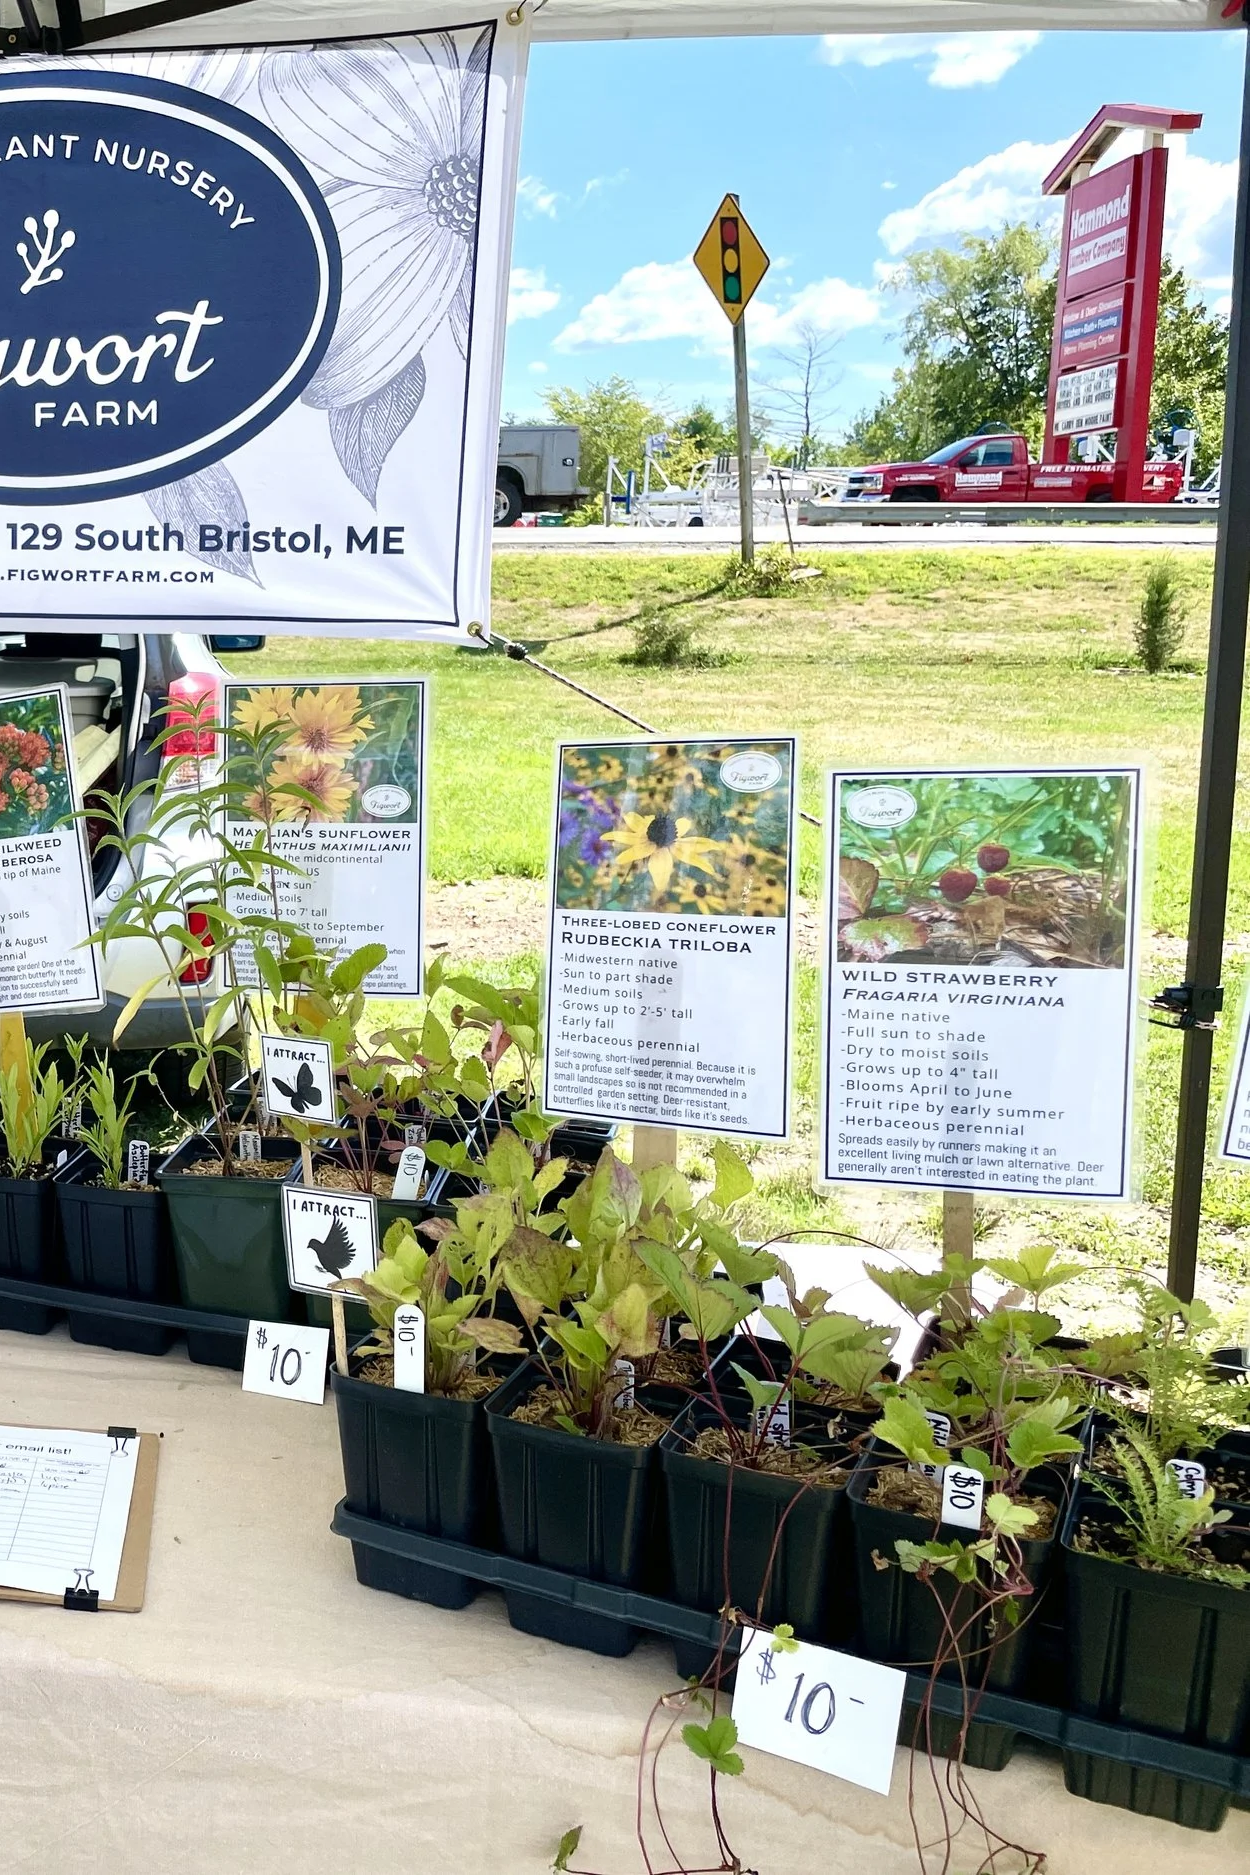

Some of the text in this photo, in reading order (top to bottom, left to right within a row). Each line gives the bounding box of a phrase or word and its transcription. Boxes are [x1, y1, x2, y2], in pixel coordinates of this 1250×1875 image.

[93, 138, 255, 230] NURSERY
[1070, 184, 1131, 240] Hammond
[1093, 235, 1125, 260] Company
[34, 399, 158, 427] FARM
[1040, 464, 1112, 473] FREE ESTIMATES
[6, 523, 63, 551] 129
[75, 522, 184, 551] South
[200, 521, 332, 559] Bristol,
[346, 525, 405, 555] ME
[318, 830, 411, 839] SUNFLOWER
[321, 843, 411, 852] MAXIMILIANII
[284, 854, 382, 864] the midcontinental
[3, 871, 17, 881] tip
[18, 868, 29, 878] of
[31, 866, 61, 876] Maine
[311, 908, 327, 917] tall
[327, 921, 384, 933] September
[562, 915, 776, 936] THREE-LOBED CONEFLOWER
[562, 931, 752, 953] RUDBECKIA TRILOBA
[638, 958, 678, 969] native
[589, 971, 601, 980] to
[605, 972, 630, 983] part
[635, 973, 673, 985] shade
[842, 970, 1058, 987] WILD STRAWBERRY
[842, 989, 1064, 1007] FRAGARIA VIRGINIANA
[595, 1017, 614, 1029] fall
[901, 1012, 950, 1023] native
[881, 1030, 908, 1039] sun
[916, 1030, 931, 1040] to
[938, 1030, 985, 1043] shade
[637, 1040, 700, 1053] perennial
[910, 1083, 947, 1097] April
[954, 1086, 970, 1097] to
[975, 1087, 1012, 1100] June
[889, 1100, 919, 1114] ripe
[926, 1101, 944, 1116] by
[950, 1104, 991, 1119] early
[997, 1108, 1064, 1119] summer
[838, 1133, 1056, 1157] Spreads easily by runners making it an
[48, 1447, 72, 1455] list!
[949, 1471, 982, 1510] $10
